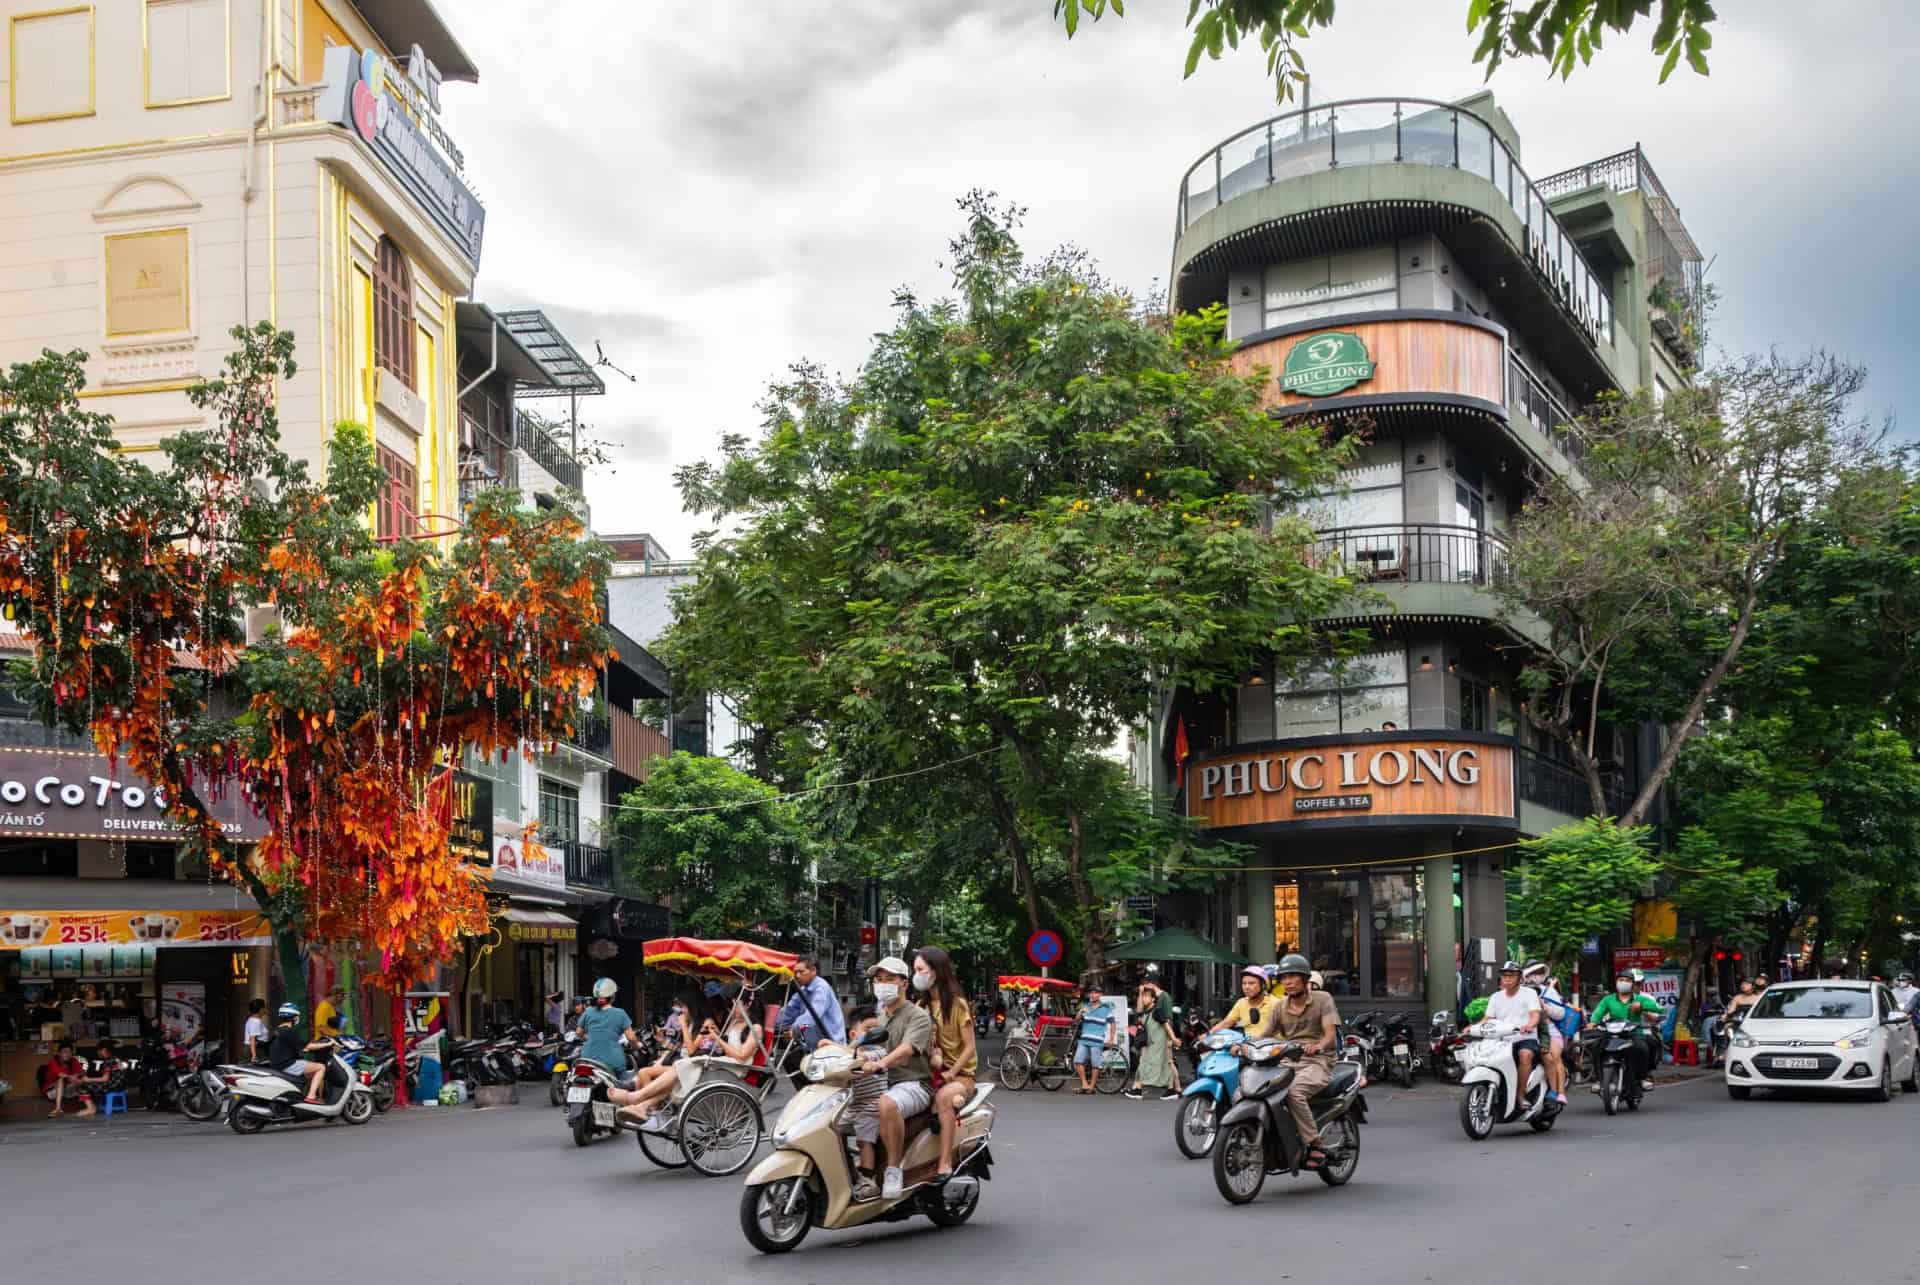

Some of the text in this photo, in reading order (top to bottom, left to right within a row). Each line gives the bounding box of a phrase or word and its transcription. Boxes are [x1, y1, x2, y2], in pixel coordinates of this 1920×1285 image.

[1283, 369, 1325, 388] PHUC
[1327, 365, 1369, 379] LONG
[1199, 746, 1481, 801] PHUC LONG
[1295, 796, 1370, 809] COFFEE & TEA
[60, 925, 109, 944] 25k
[199, 924, 241, 942] 25k
